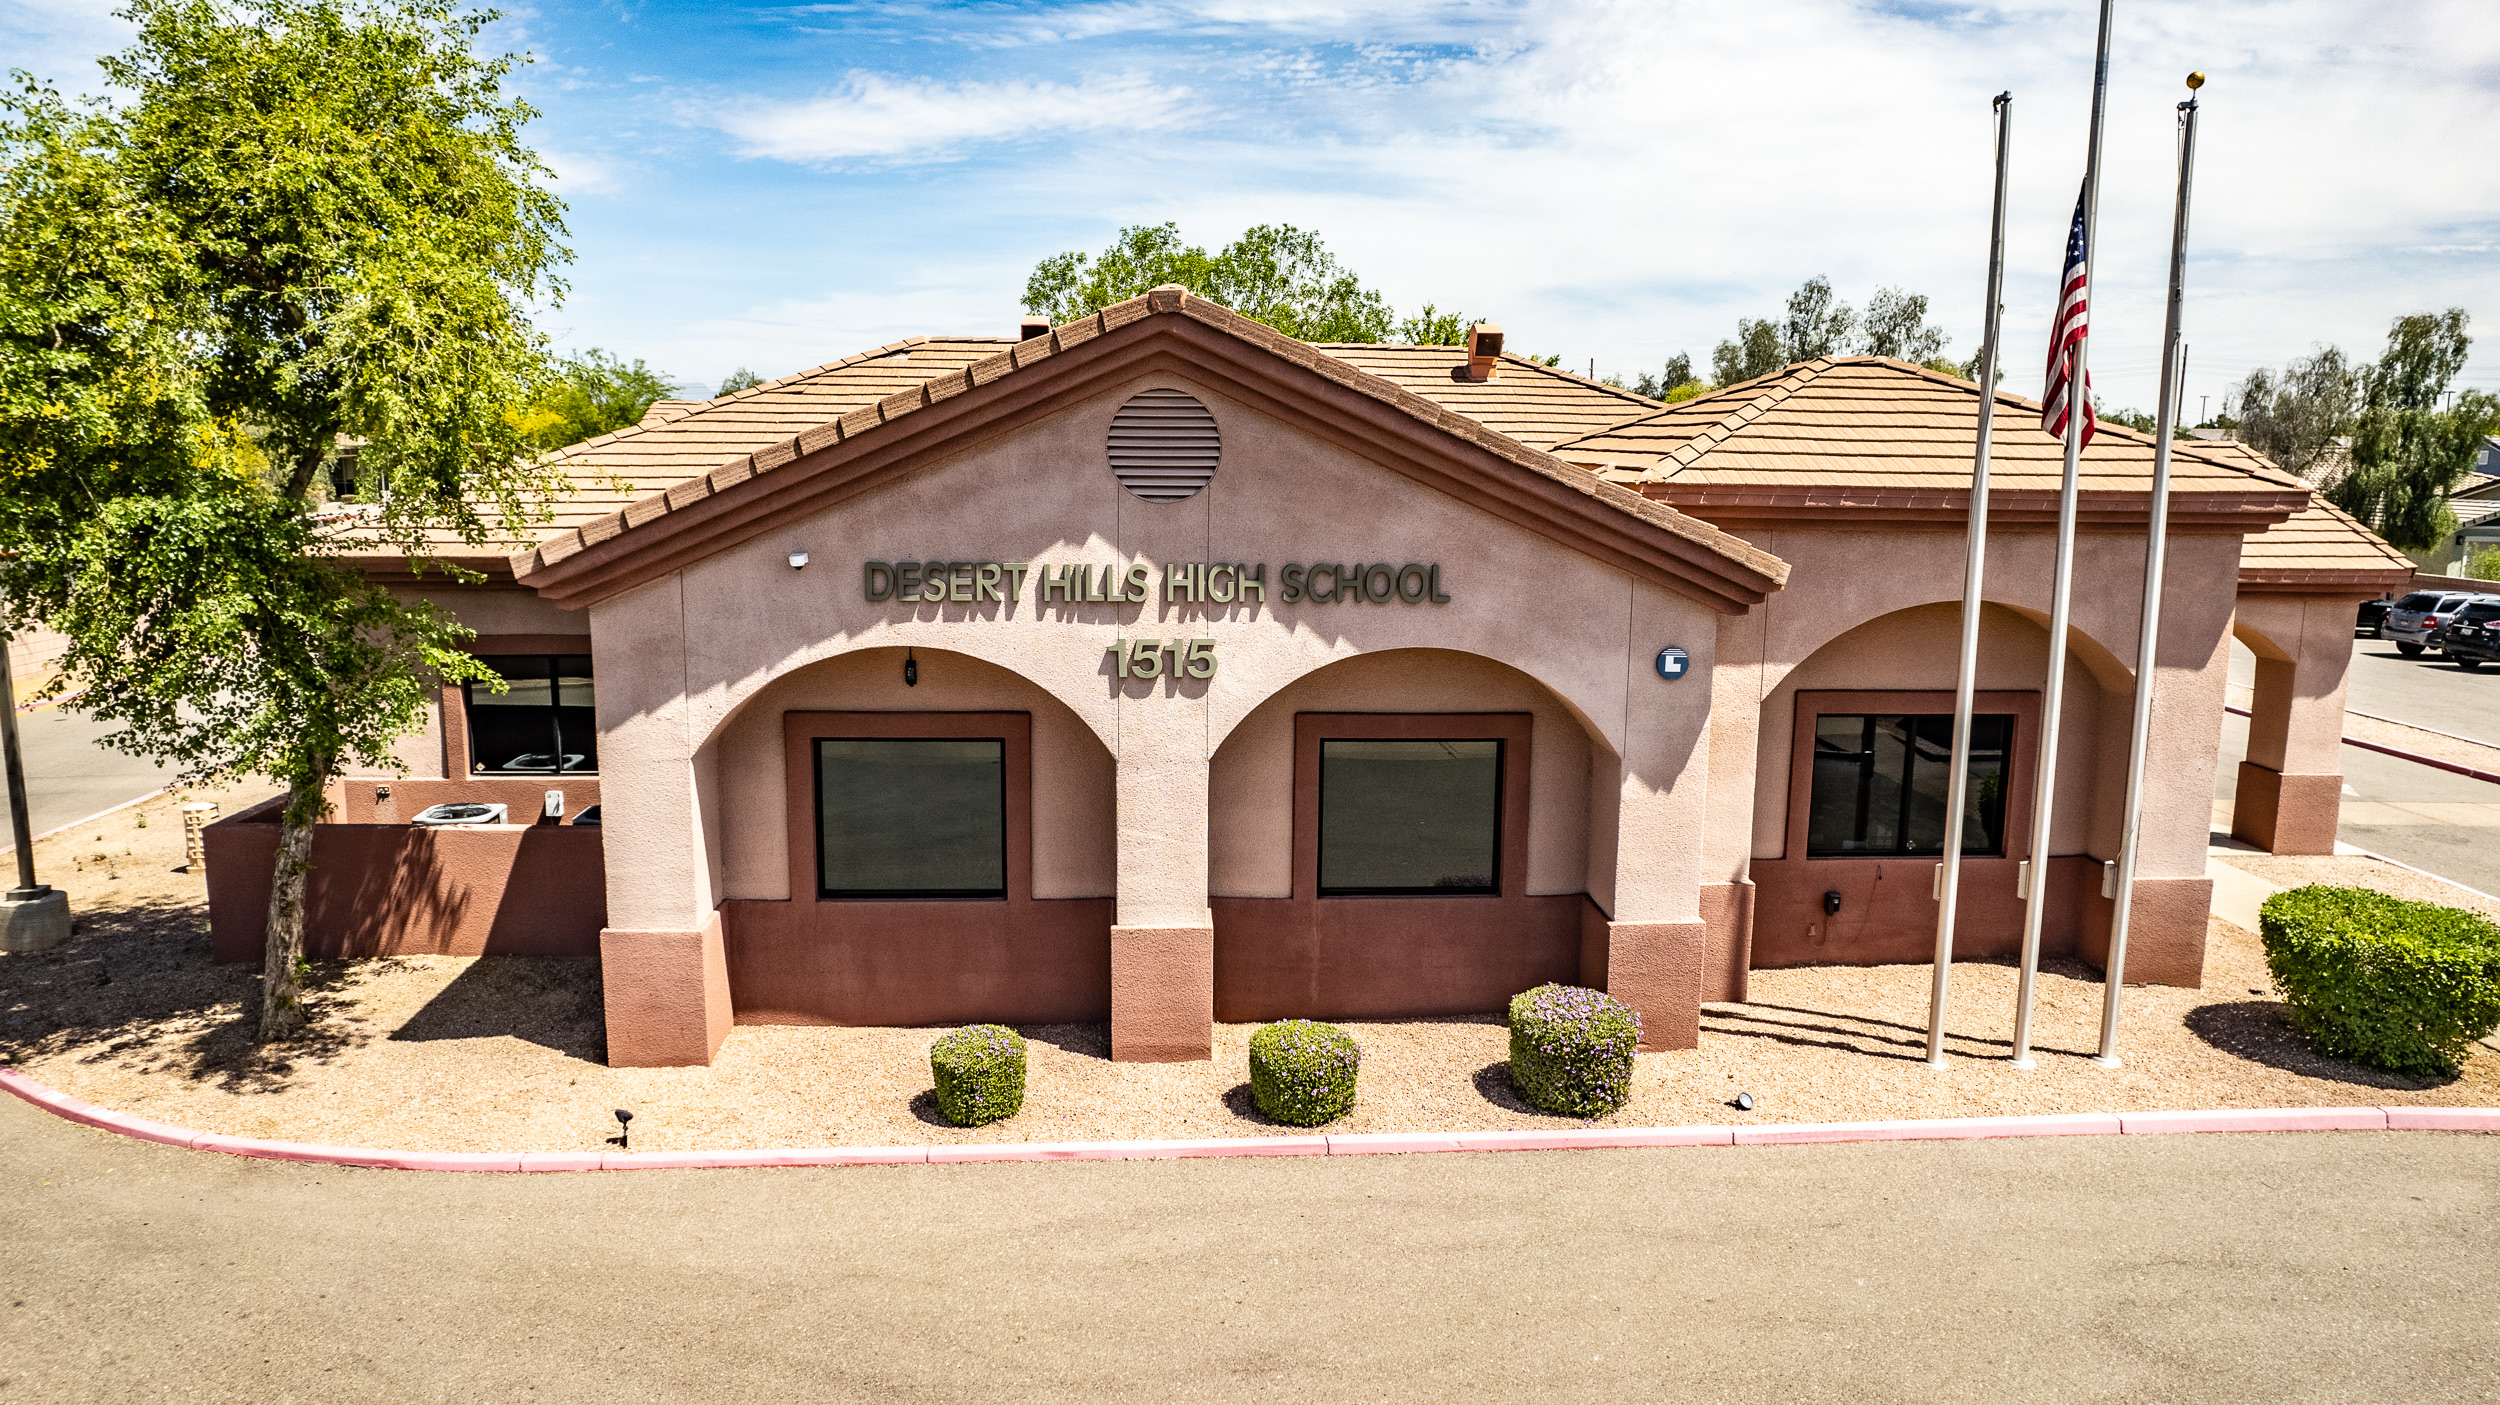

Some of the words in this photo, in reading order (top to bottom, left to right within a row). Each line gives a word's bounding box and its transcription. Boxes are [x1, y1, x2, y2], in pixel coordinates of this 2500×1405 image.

[865, 562, 1028, 602] DESERT
[1043, 564, 1150, 602] HILLS
[1167, 564, 1265, 602] HIGH
[1282, 563, 1451, 603] SCHOOL
[1107, 639, 1218, 679] 1515
